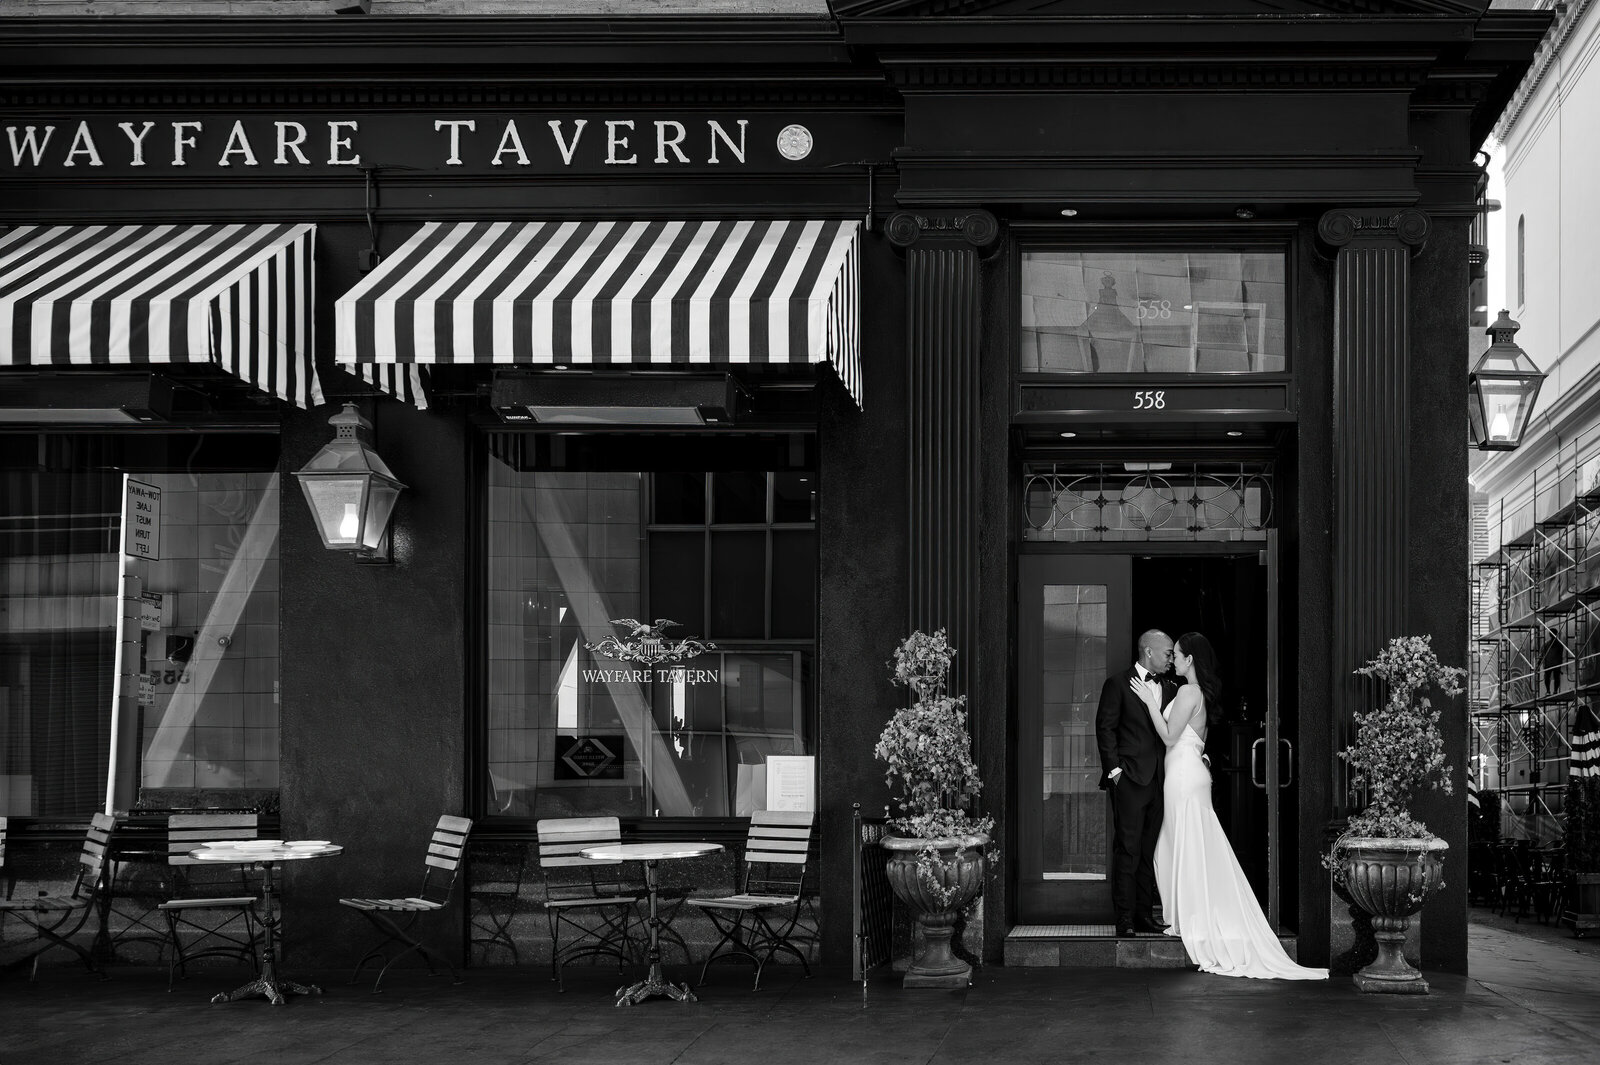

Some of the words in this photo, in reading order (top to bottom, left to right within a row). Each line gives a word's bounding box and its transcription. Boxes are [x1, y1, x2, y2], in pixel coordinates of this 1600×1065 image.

[6, 119, 362, 167] WAYFARE
[434, 118, 749, 166] TAVERN
[1136, 300, 1171, 319] 558
[1133, 391, 1165, 409] 558
[582, 669, 653, 683] WAYFARE
[657, 669, 719, 683] TAVERN
